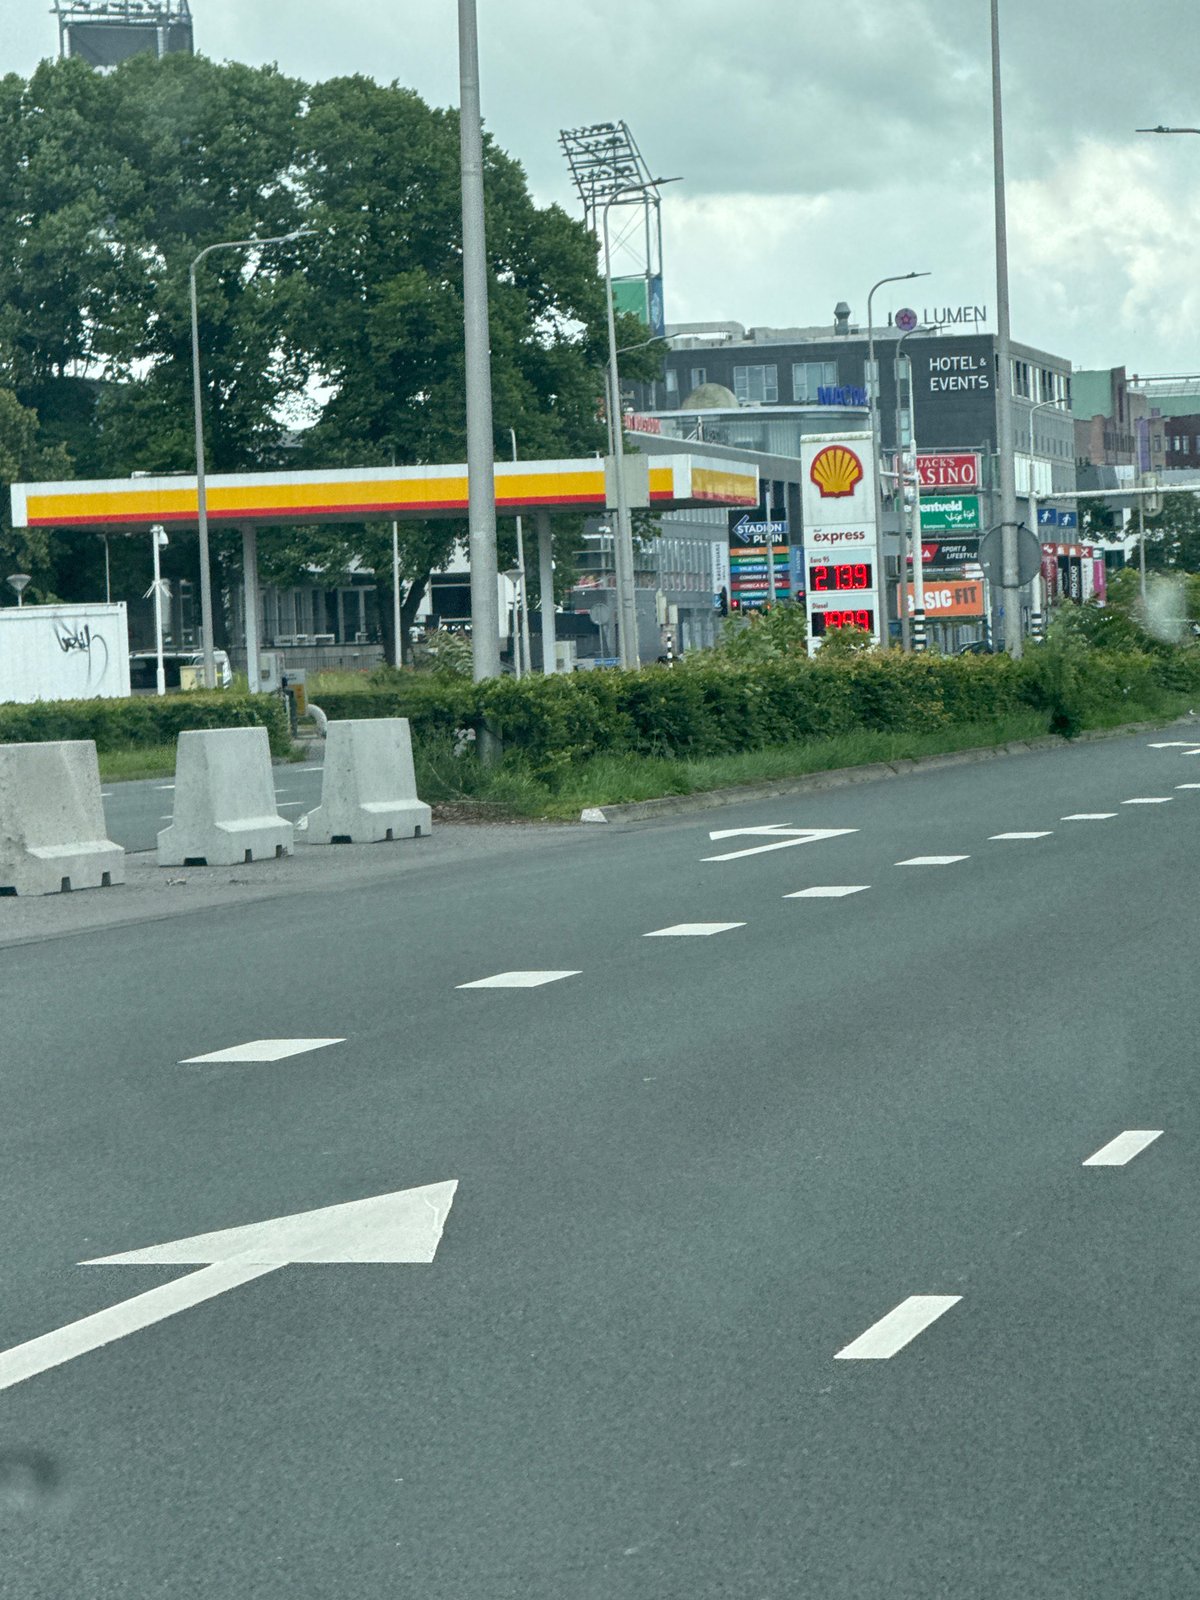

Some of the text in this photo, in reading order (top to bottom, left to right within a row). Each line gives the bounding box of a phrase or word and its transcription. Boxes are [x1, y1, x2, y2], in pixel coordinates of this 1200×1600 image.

[924, 306, 986, 325] LUMEN
[929, 356, 986, 371] HOTEL &
[930, 375, 989, 391] EVENTS
[919, 458, 955, 467] JACK'S
[917, 464, 974, 484] ASINO
[753, 534, 783, 543] PLIN
[813, 531, 865, 545] express
[907, 586, 977, 612] BSIC-FIT
